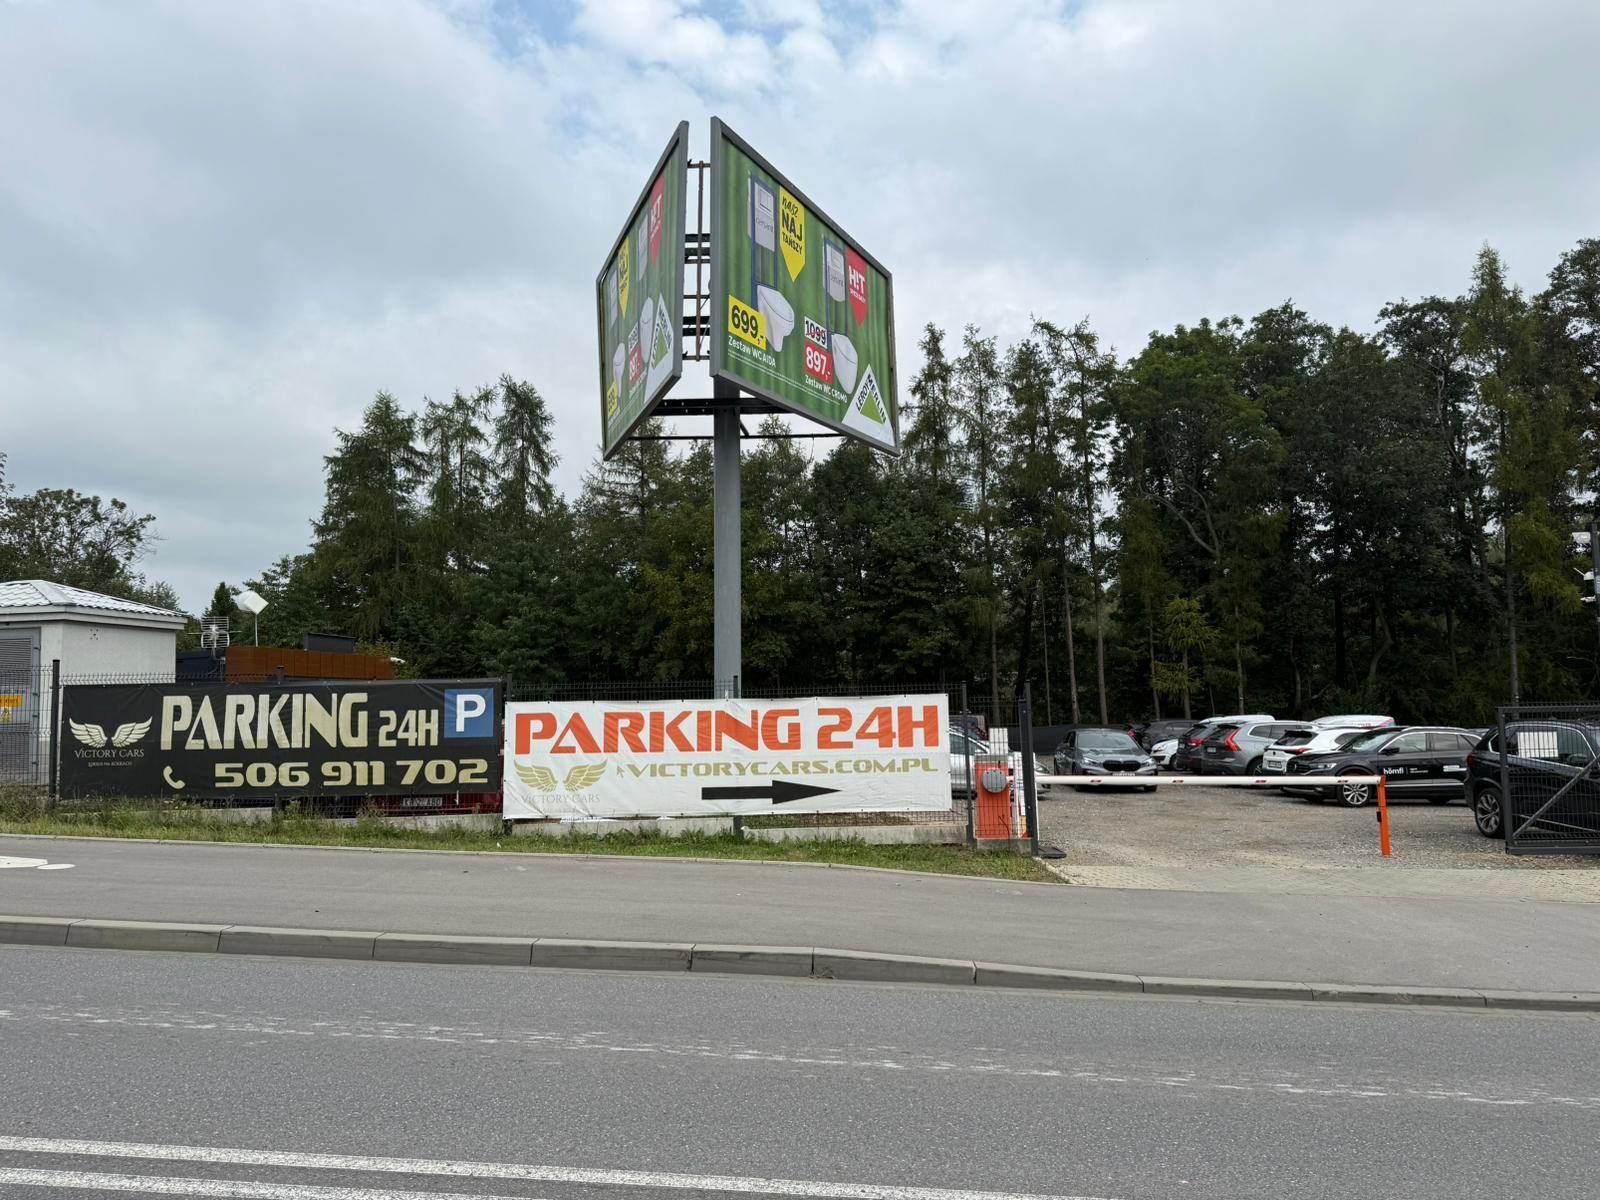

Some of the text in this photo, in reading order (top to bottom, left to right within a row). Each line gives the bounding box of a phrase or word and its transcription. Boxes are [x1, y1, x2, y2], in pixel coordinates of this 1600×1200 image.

[781, 209, 803, 241] NAJ
[781, 231, 803, 255] TAŃSZY
[728, 335, 751, 355] Zestaw
[805, 320, 827, 345] 1099
[855, 381, 871, 412] LEROY
[160, 692, 439, 750] PARKING 24H
[455, 694, 487, 732] P
[514, 705, 941, 755] PARKING 24H
[74, 749, 145, 758] VICTORY CARS
[214, 758, 489, 788] 506 911 702
[626, 758, 939, 779] VICTORYCARS.COM.PL
[520, 794, 570, 805] VICTORY
